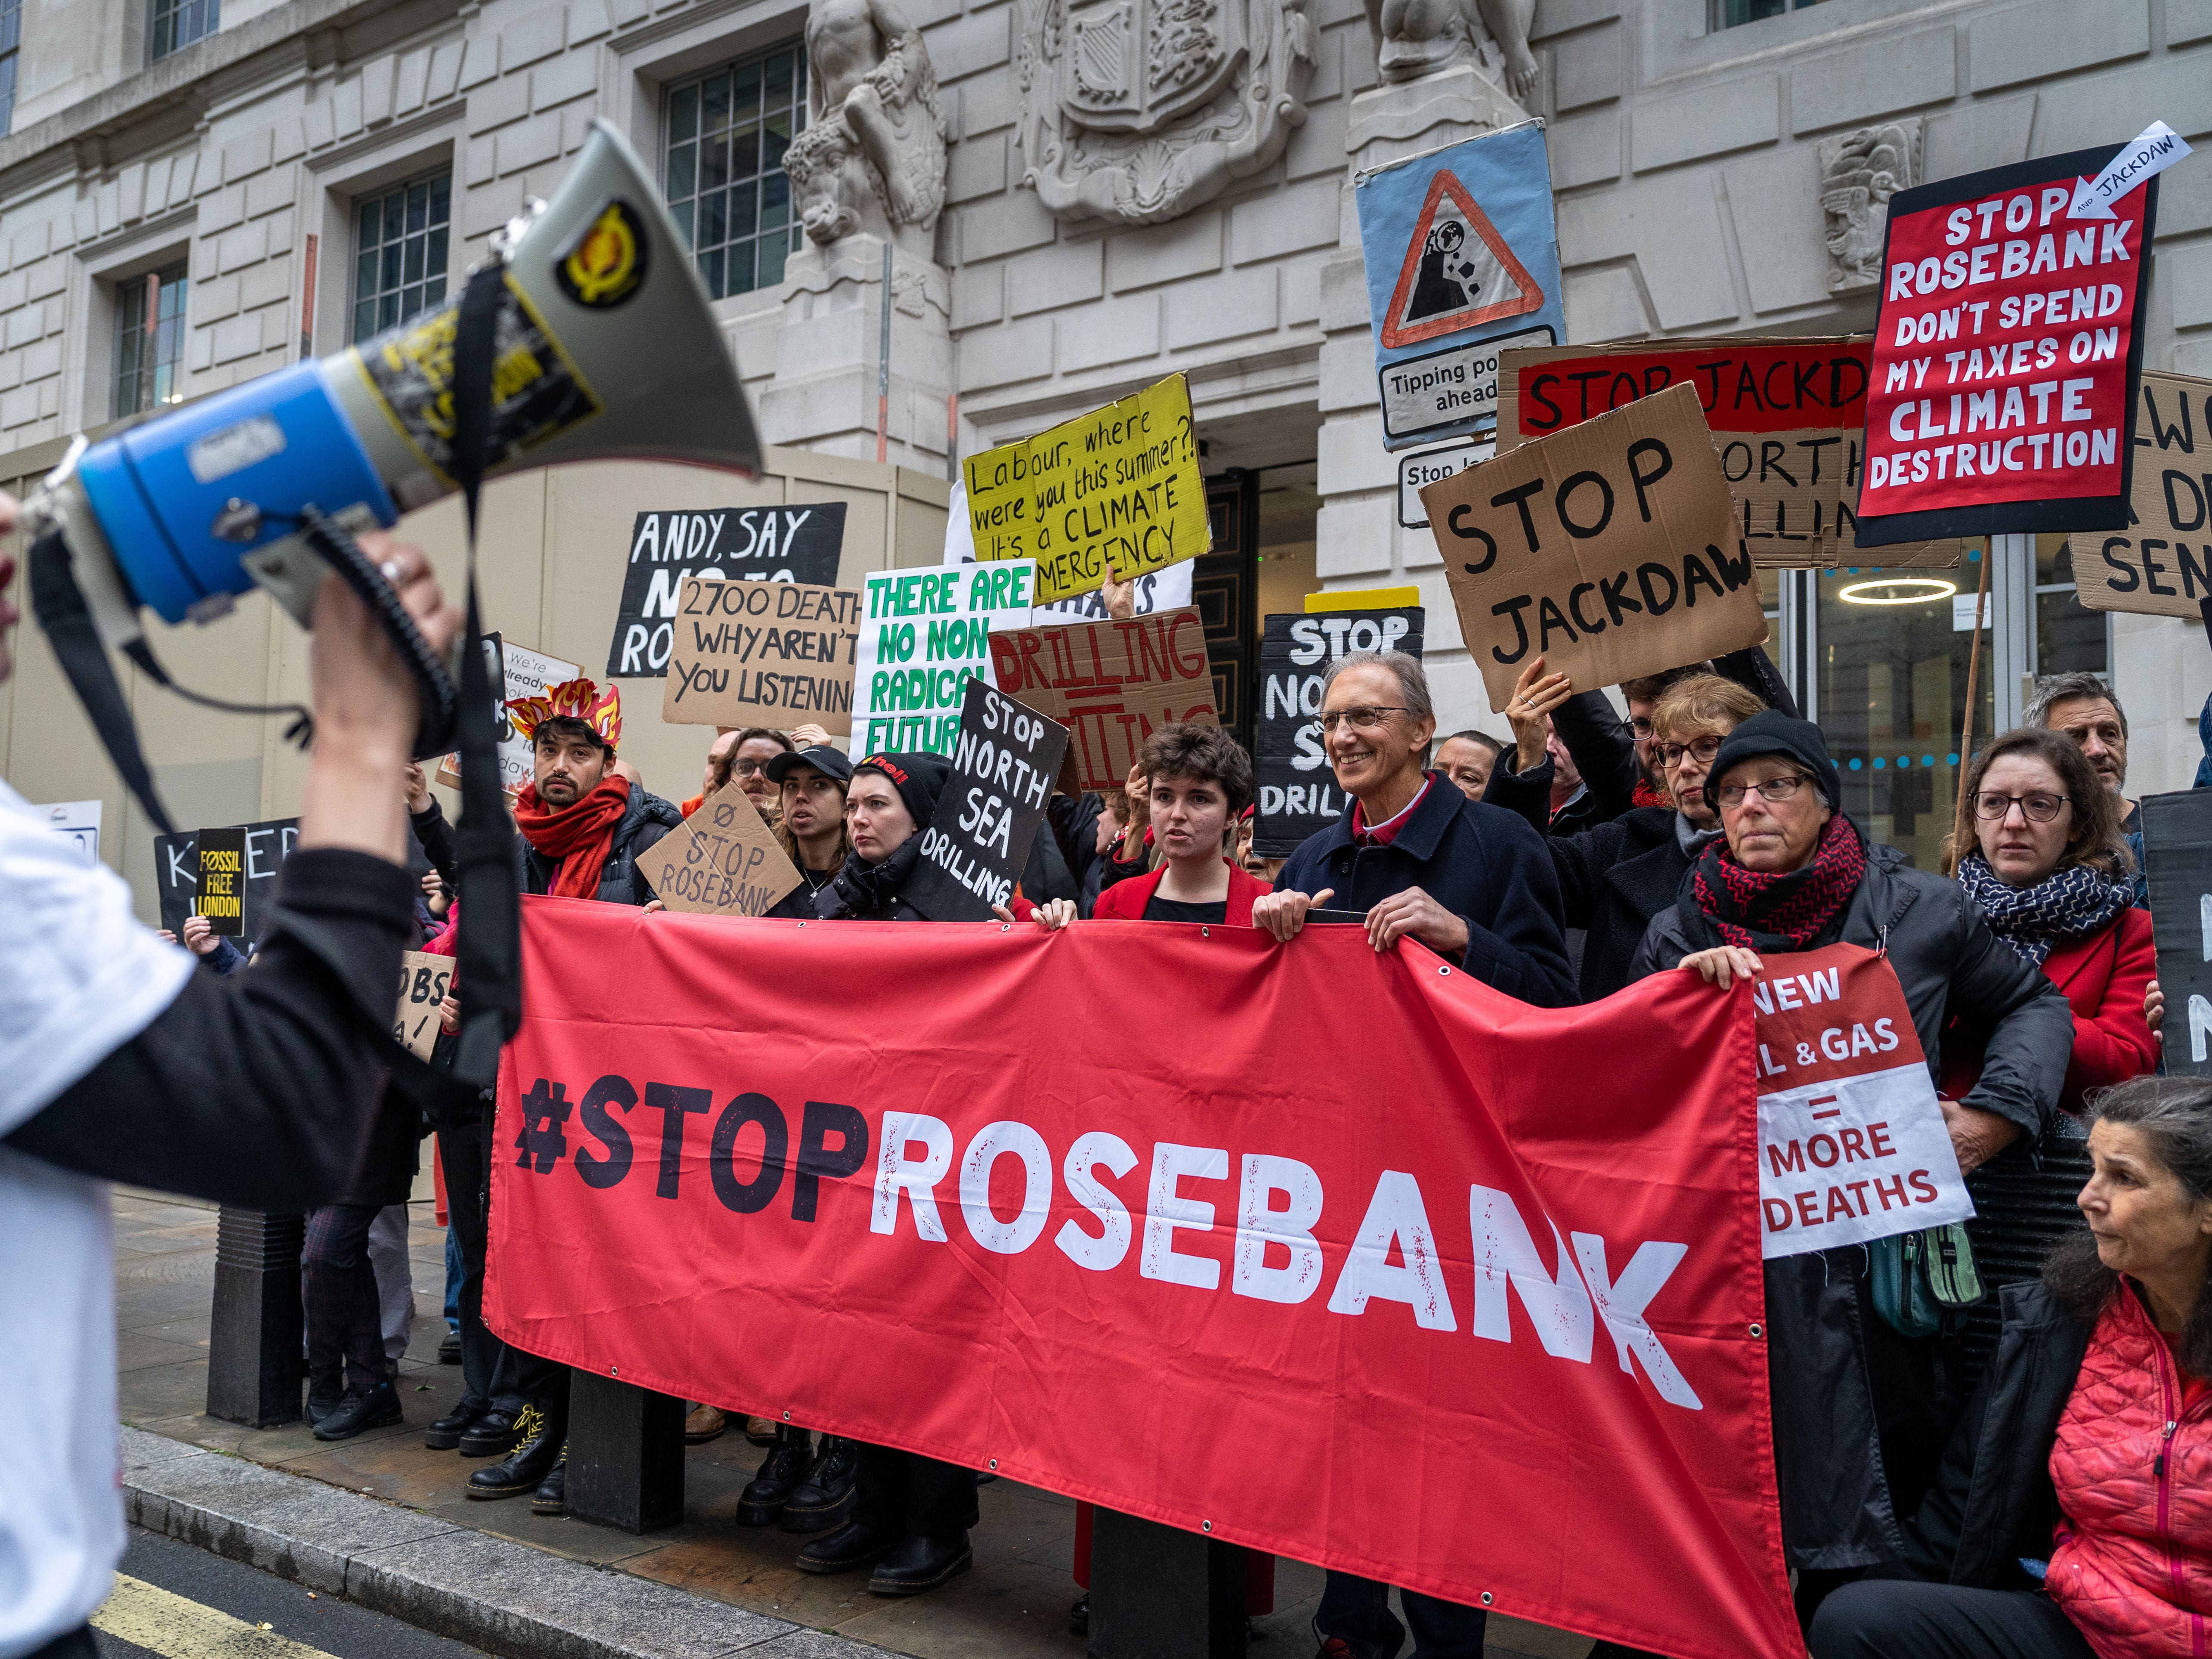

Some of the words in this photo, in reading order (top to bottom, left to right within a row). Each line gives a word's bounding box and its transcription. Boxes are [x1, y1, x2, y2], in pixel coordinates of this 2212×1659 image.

[2078, 198, 2093, 212] AND
[2095, 135, 2174, 197] JACKDAW
[1945, 188, 2069, 246] STOP
[1889, 220, 2134, 302] ROSEBANK
[1894, 301, 1990, 347] DON'T
[1999, 284, 2122, 329] SPEND
[1391, 365, 1464, 395] Tipping
[1884, 356, 1932, 394] MY
[1945, 337, 2058, 384] TAXES
[2069, 326, 2119, 364] ON
[1436, 380, 1498, 411] ahead
[1527, 365, 1671, 429] STOP
[1889, 377, 2094, 442] CLIMATE
[971, 441, 1072, 495] Labour,
[1085, 411, 1151, 453] where
[975, 497, 1024, 531] were
[1035, 481, 1066, 523] you
[1075, 462, 1108, 500] this
[1116, 415, 1195, 485] summer?!
[1869, 427, 2116, 490] DESTRUCTION
[991, 535, 1024, 561] It's
[1038, 526, 1050, 550] a
[1064, 474, 1179, 543] CLIMATE
[1448, 437, 1672, 574] STOP
[631, 513, 726, 563] ANDY,
[730, 510, 811, 559] SAY
[1034, 516, 1175, 599] MERGENCY
[684, 580, 770, 616] 2700
[866, 572, 960, 619] THERE
[969, 566, 1032, 610] ARE
[1491, 538, 1751, 665] JACKDAW
[510, 652, 547, 673] We're
[693, 621, 762, 664] WHY
[877, 623, 916, 665] NO
[926, 617, 990, 662] NON
[987, 612, 1206, 694] DRILLING
[1289, 615, 1409, 666] STOP
[505, 668, 547, 692] lready
[674, 659, 729, 703] YOU
[737, 668, 854, 714] LISTENIN
[982, 691, 1045, 753] STOP
[954, 729, 1049, 810] NORTH
[959, 787, 1012, 859] SEA
[1259, 783, 1353, 817] DRIL
[167, 827, 300, 888] KEP
[206, 873, 233, 894] FREE
[686, 831, 765, 879] STOP
[920, 826, 1012, 907] DRILLING
[198, 896, 241, 917] LONDON
[658, 863, 777, 917] ROSEBANK
[1754, 966, 1841, 1019] NEW
[1796, 1042, 1818, 1066] &
[1820, 1017, 1899, 1061] GAS
[1767, 1121, 1897, 1178] MORE
[1761, 1169, 1938, 1232] DEATHS
